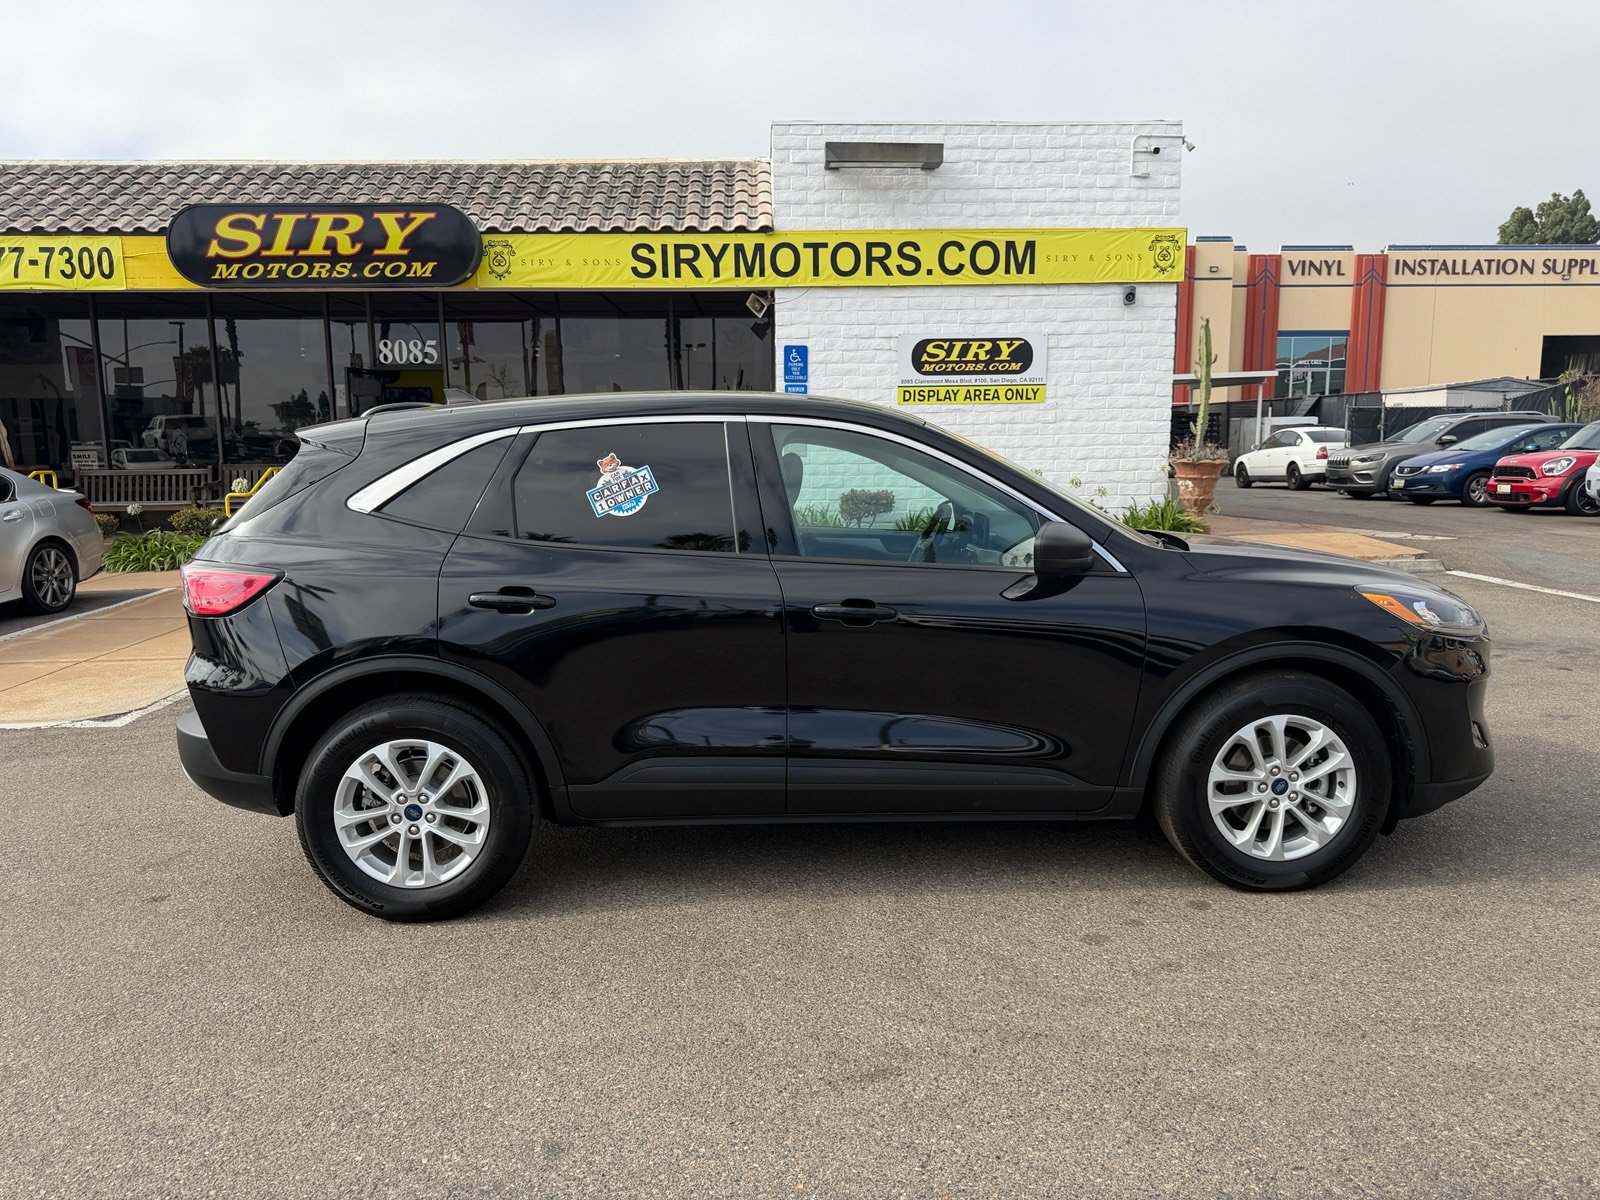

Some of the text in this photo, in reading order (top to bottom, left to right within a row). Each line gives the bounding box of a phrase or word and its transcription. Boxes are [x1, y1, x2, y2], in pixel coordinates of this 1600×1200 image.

[205, 211, 437, 258] SIRY
[521, 258, 621, 266] SIRY & SONS
[630, 240, 1036, 279] SIRYMOTORS.COM
[1046, 253, 1143, 262] SIRY & SONS
[211, 262, 437, 279] MOTORS.COM
[1288, 259, 1345, 276] VINYL
[1394, 258, 1599, 276] INSTALLATION SUPPL
[378, 339, 438, 364] 8085
[921, 340, 1025, 362] SIRY
[921, 362, 1023, 372] MOTORS.COM
[902, 388, 1040, 402] DISPLAY AREA ONLY
[593, 474, 648, 501] CARFAX
[598, 503, 606, 511] 1
[607, 482, 652, 507] OWNER
